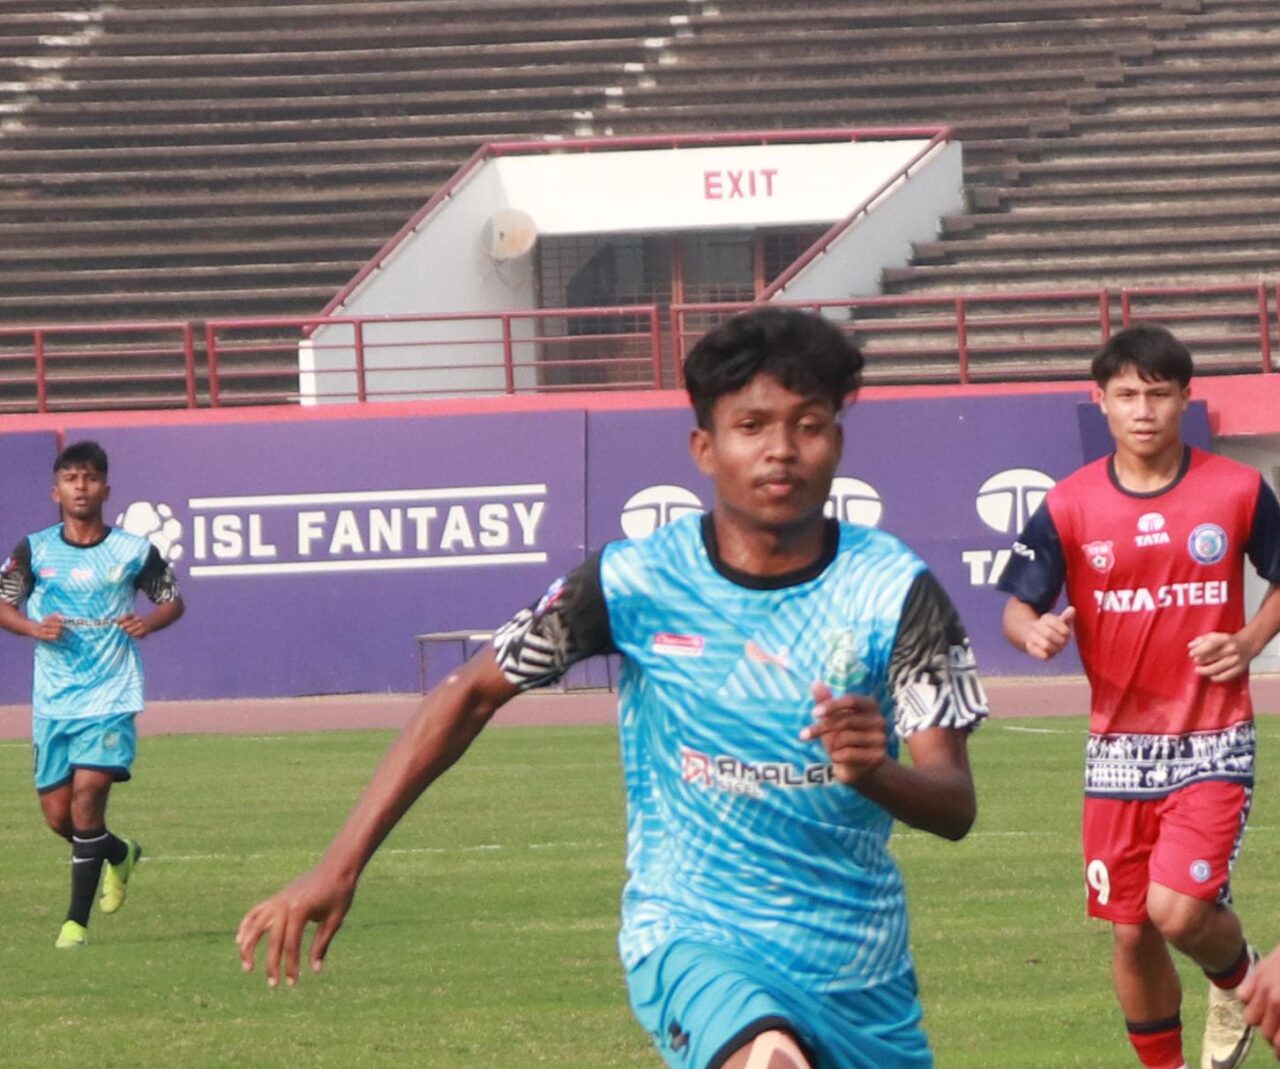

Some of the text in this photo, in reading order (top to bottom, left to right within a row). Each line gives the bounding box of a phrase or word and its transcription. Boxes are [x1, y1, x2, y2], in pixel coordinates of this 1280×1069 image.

[703, 168, 779, 200] EXIT
[193, 501, 545, 560] ISL FANTASY
[1134, 532, 1170, 547] TATA
[1093, 588, 1156, 613] TATA
